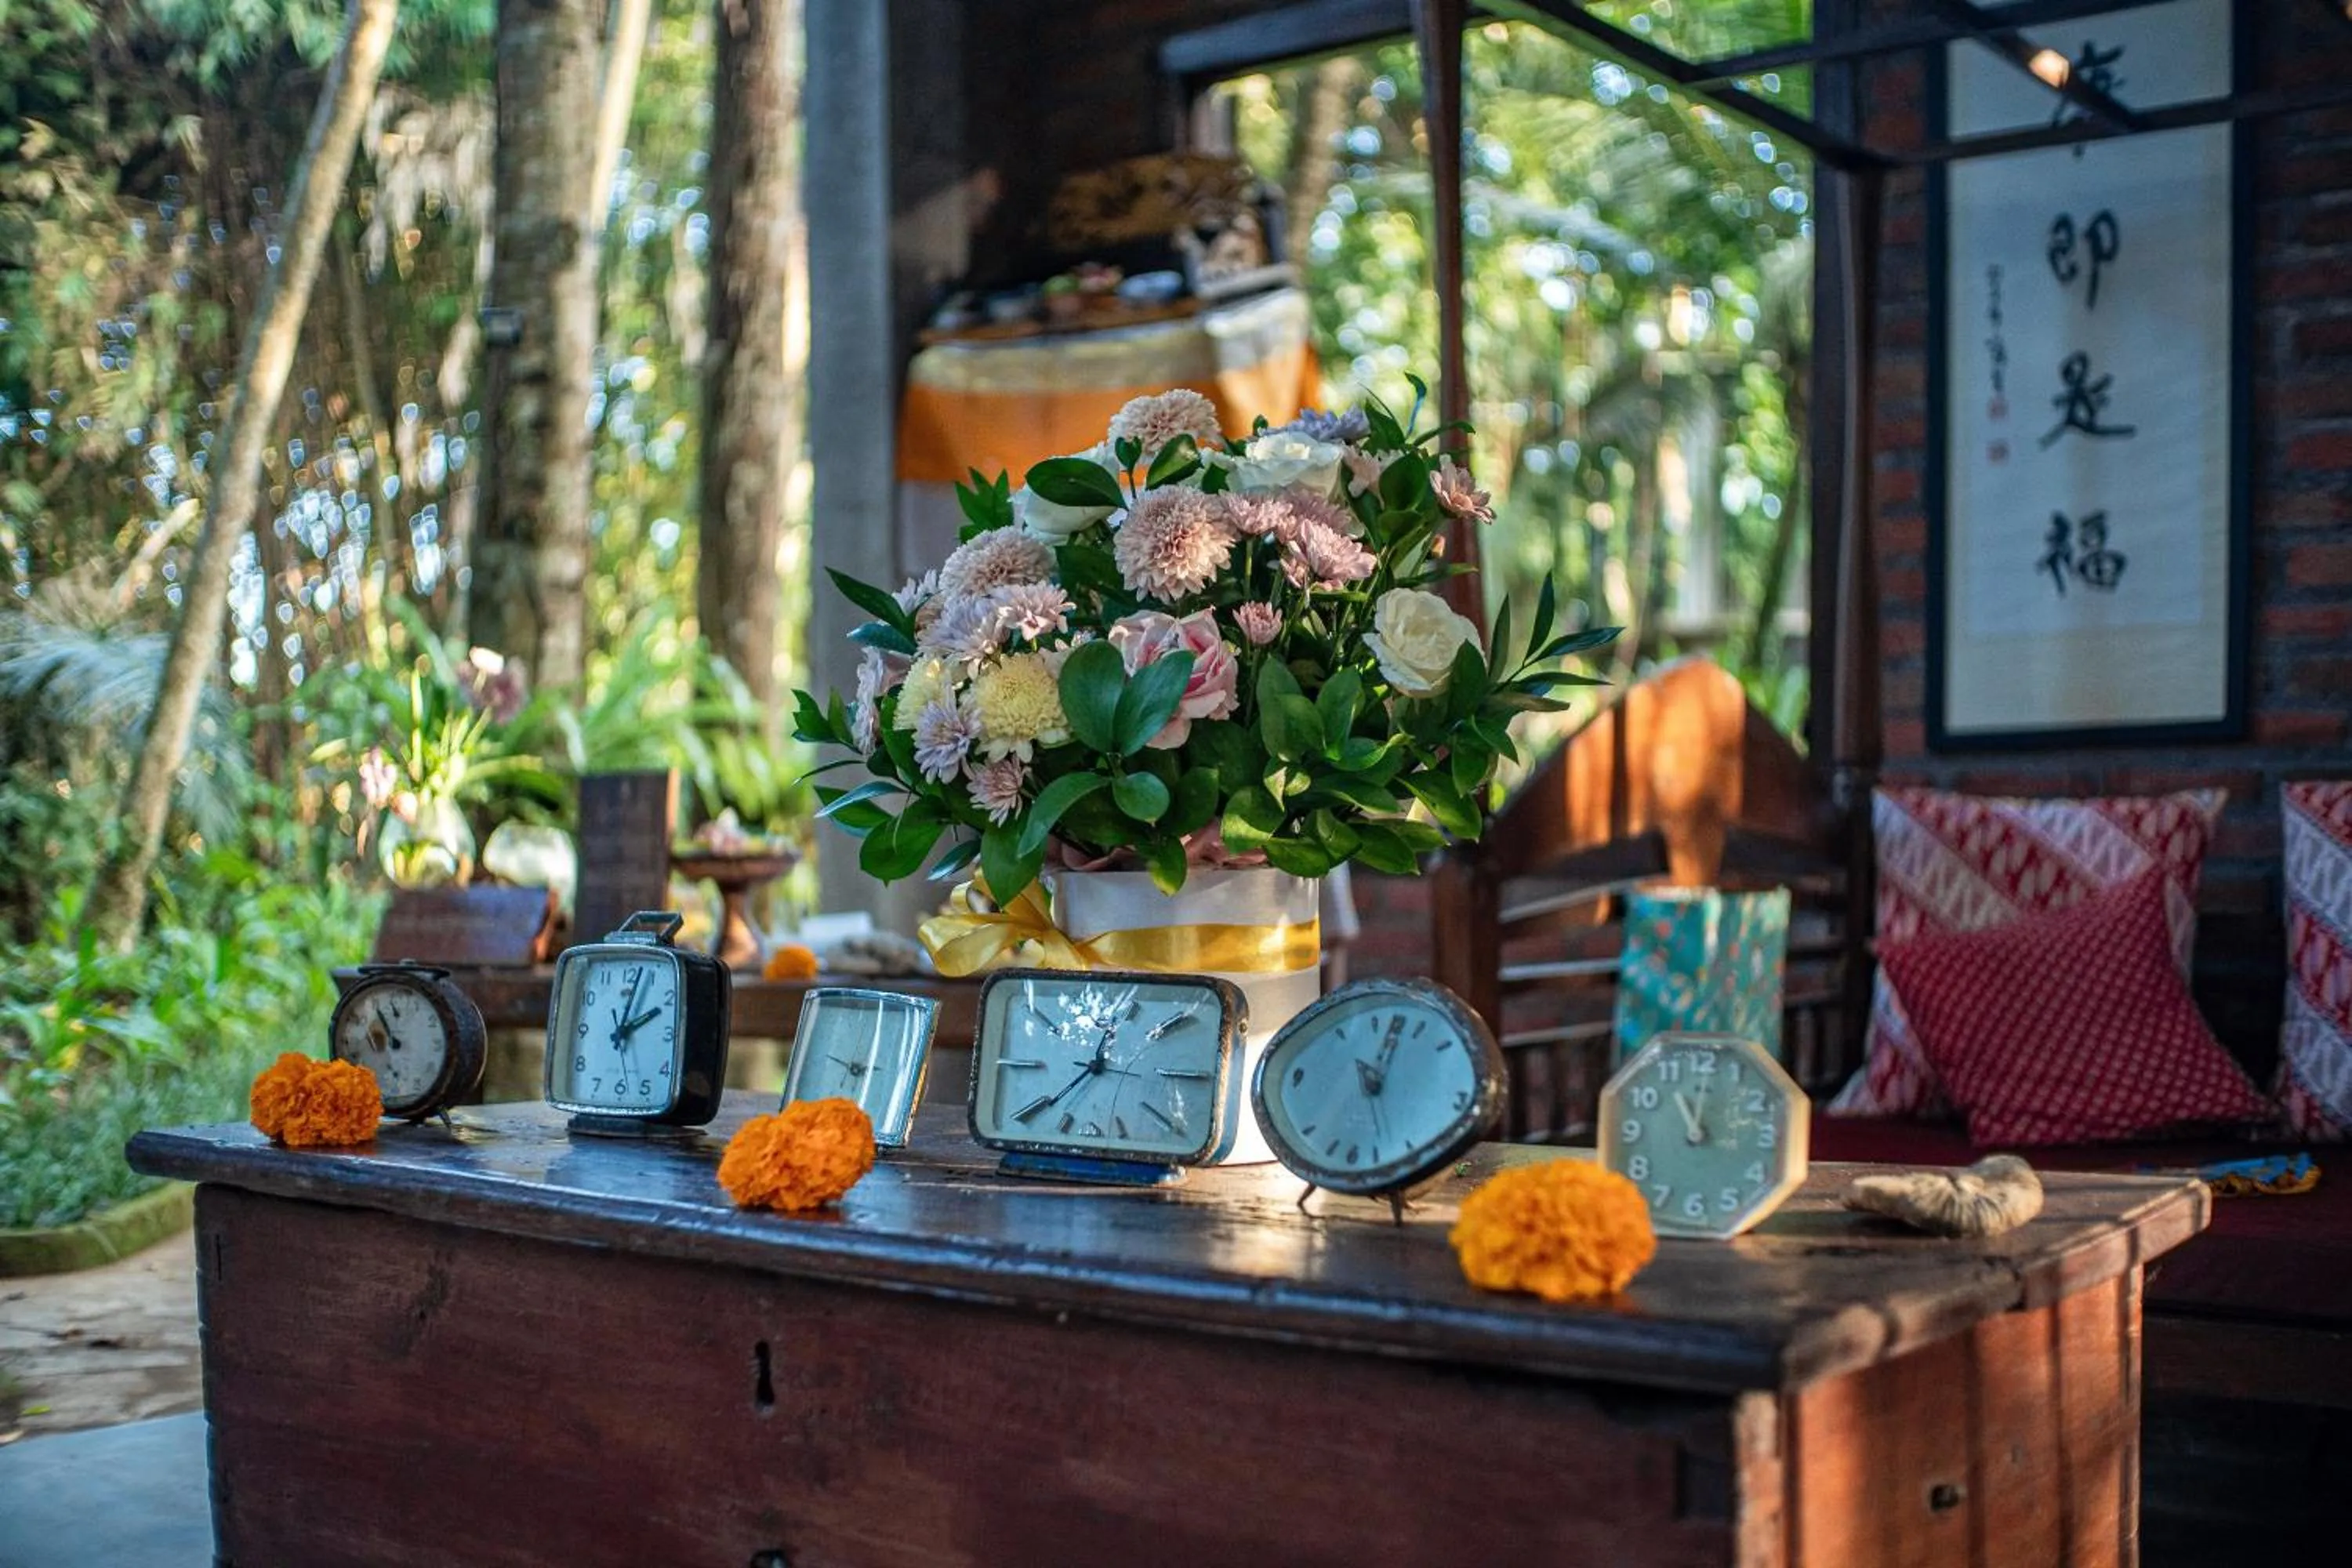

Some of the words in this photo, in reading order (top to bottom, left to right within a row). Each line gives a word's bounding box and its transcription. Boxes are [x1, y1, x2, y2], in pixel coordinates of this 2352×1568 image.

[601, 970, 611, 985] 11
[622, 967, 637, 984] 12
[583, 991, 596, 1007] 10
[664, 989, 675, 1007] 2
[578, 1023, 589, 1040] 9
[662, 1026, 674, 1043] 3
[575, 1055, 586, 1073] 8
[659, 1062, 670, 1078] 4
[1657, 1060, 1680, 1082] 11
[1690, 1051, 1716, 1074] 12
[1729, 1062, 1740, 1082] 1
[592, 1077, 602, 1093] 7
[614, 1078, 626, 1095] 6
[639, 1080, 651, 1096] 5
[1631, 1086, 1659, 1109] 10
[1747, 1090, 1766, 1112] 2
[1621, 1119, 1642, 1143] 9
[1757, 1123, 1776, 1149] 3
[1628, 1155, 1650, 1180] 8
[1744, 1160, 1764, 1184] 4
[1652, 1185, 1672, 1208] 7
[1684, 1192, 1705, 1217] 6
[1719, 1187, 1740, 1211] 5
